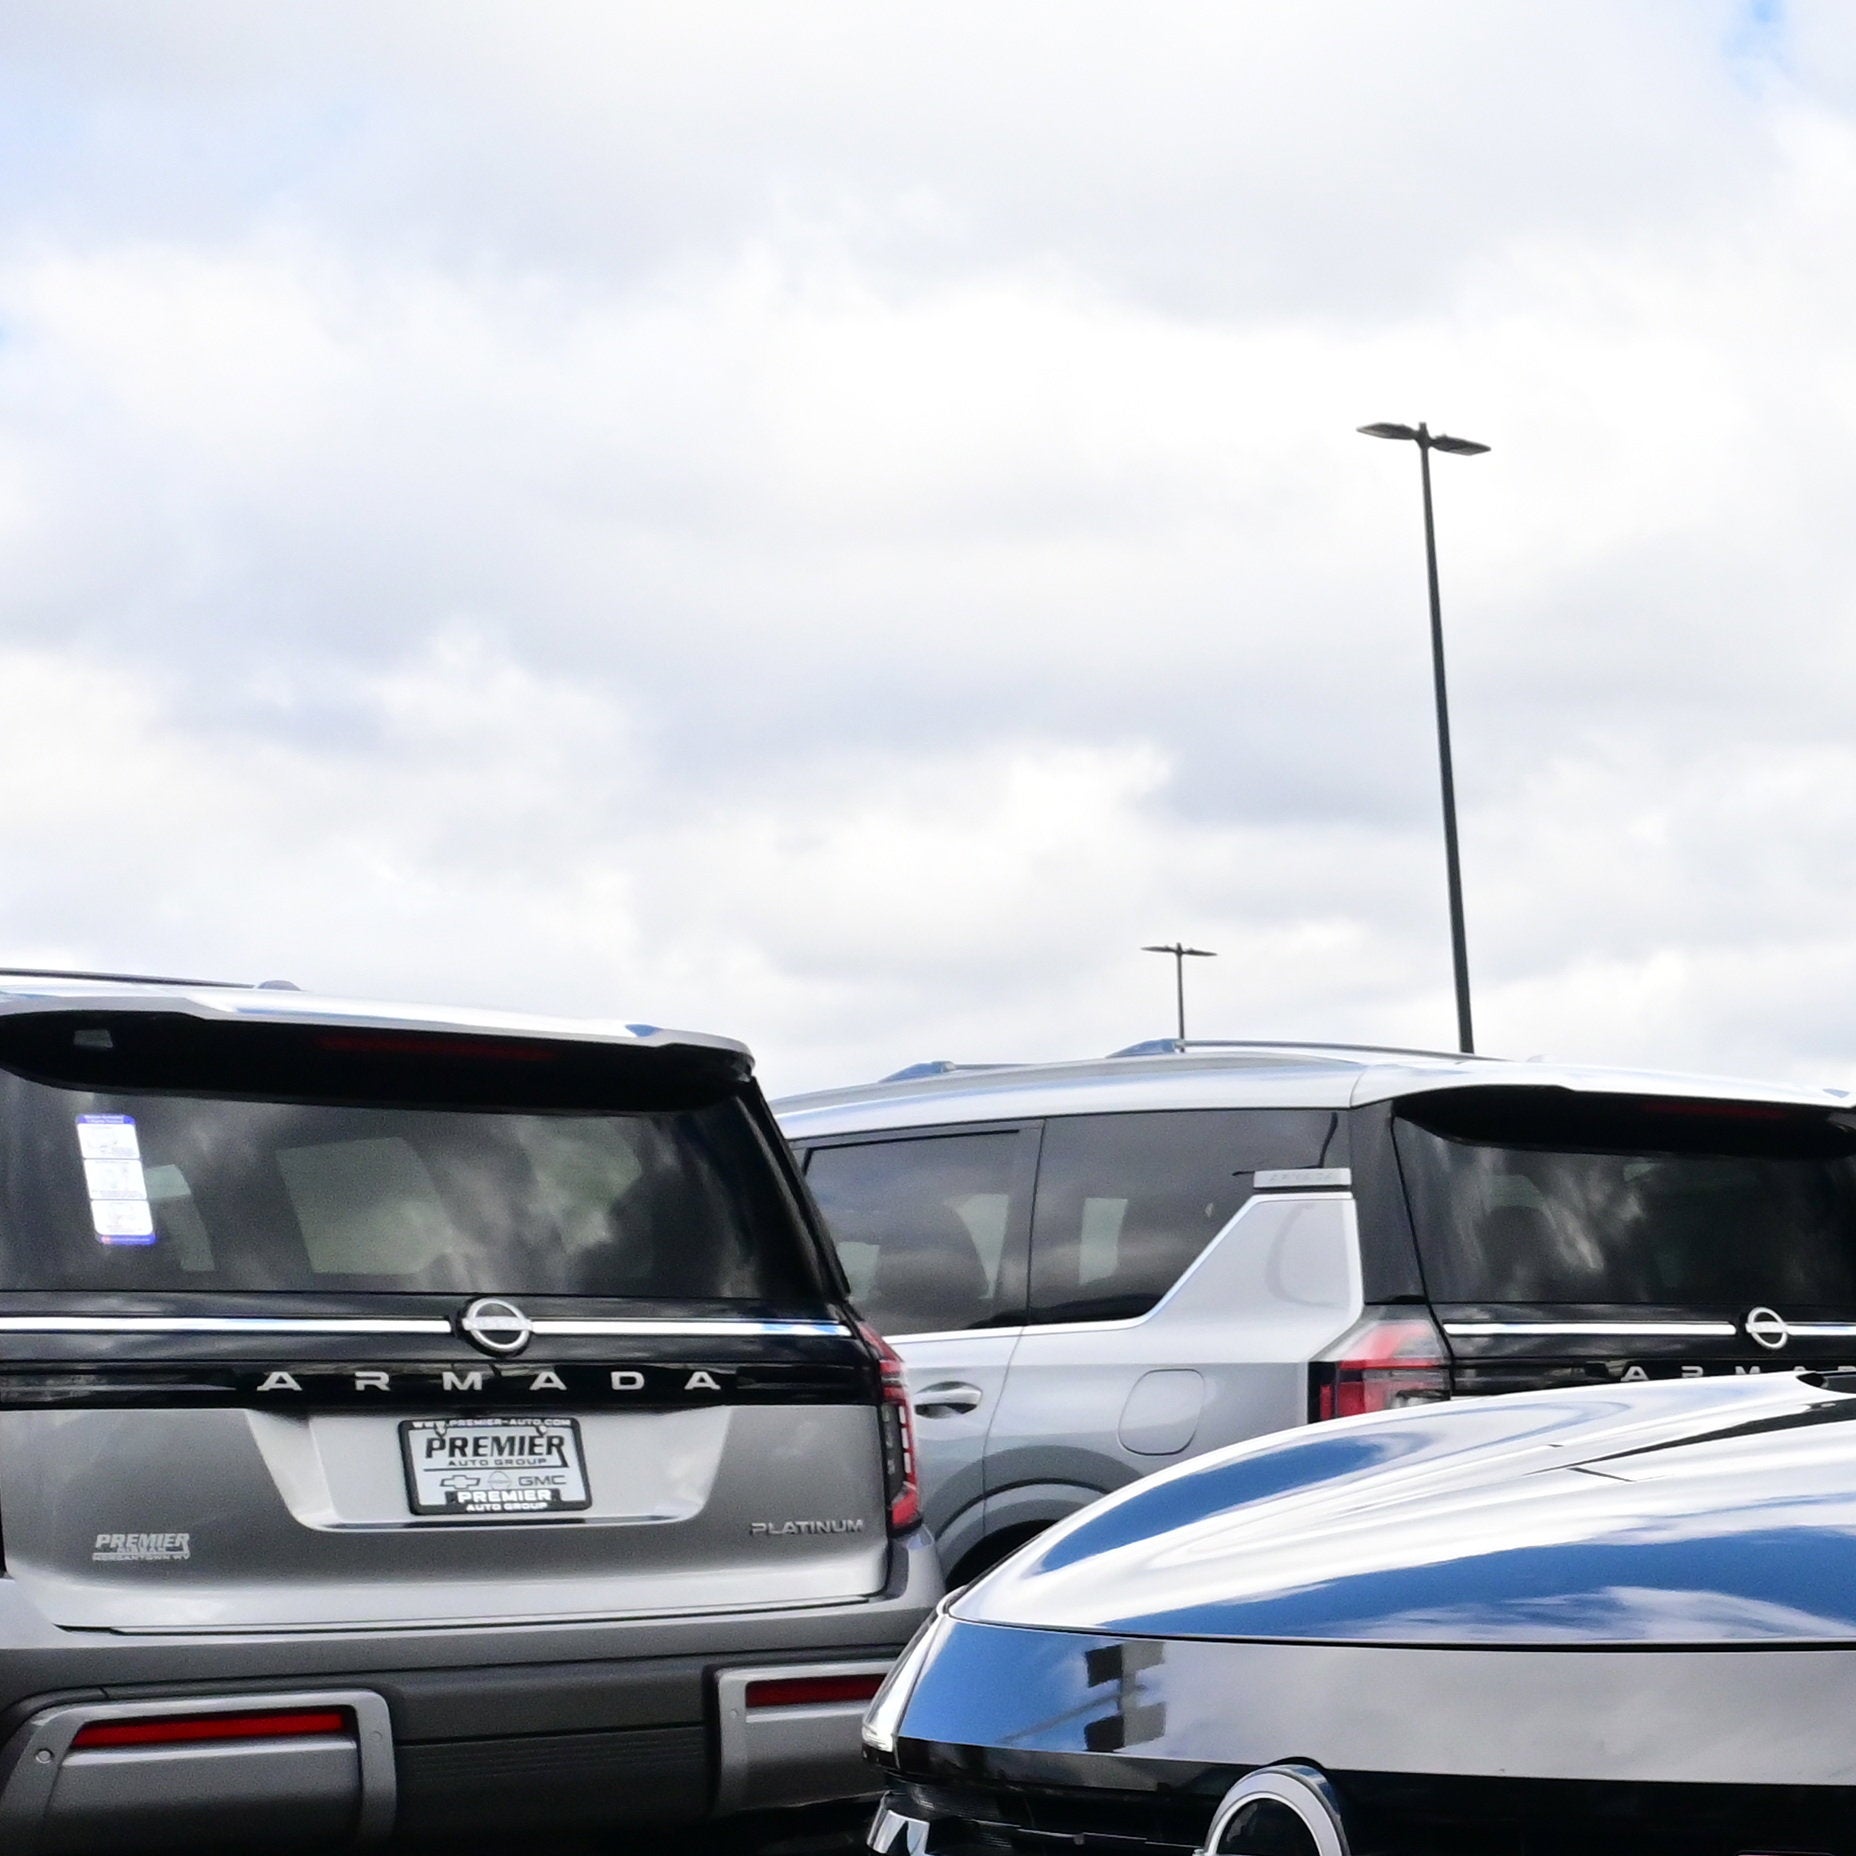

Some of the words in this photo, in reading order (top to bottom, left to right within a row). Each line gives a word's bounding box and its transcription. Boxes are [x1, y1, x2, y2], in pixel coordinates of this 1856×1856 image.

[256, 1370, 721, 1392] ARMADA
[412, 1419, 571, 1429] WWW.PREMIER-AUTO.COM
[425, 1434, 569, 1466] PREMIER
[448, 1459, 489, 1467] AUTO
[494, 1457, 548, 1466] GROUP
[518, 1474, 568, 1487] GMC
[457, 1489, 552, 1503] PREMIER
[465, 1502, 502, 1512] AUTO
[504, 1501, 548, 1511] GROUP
[750, 1519, 864, 1535] PLATINUM
[95, 1532, 190, 1553] PREMIER
